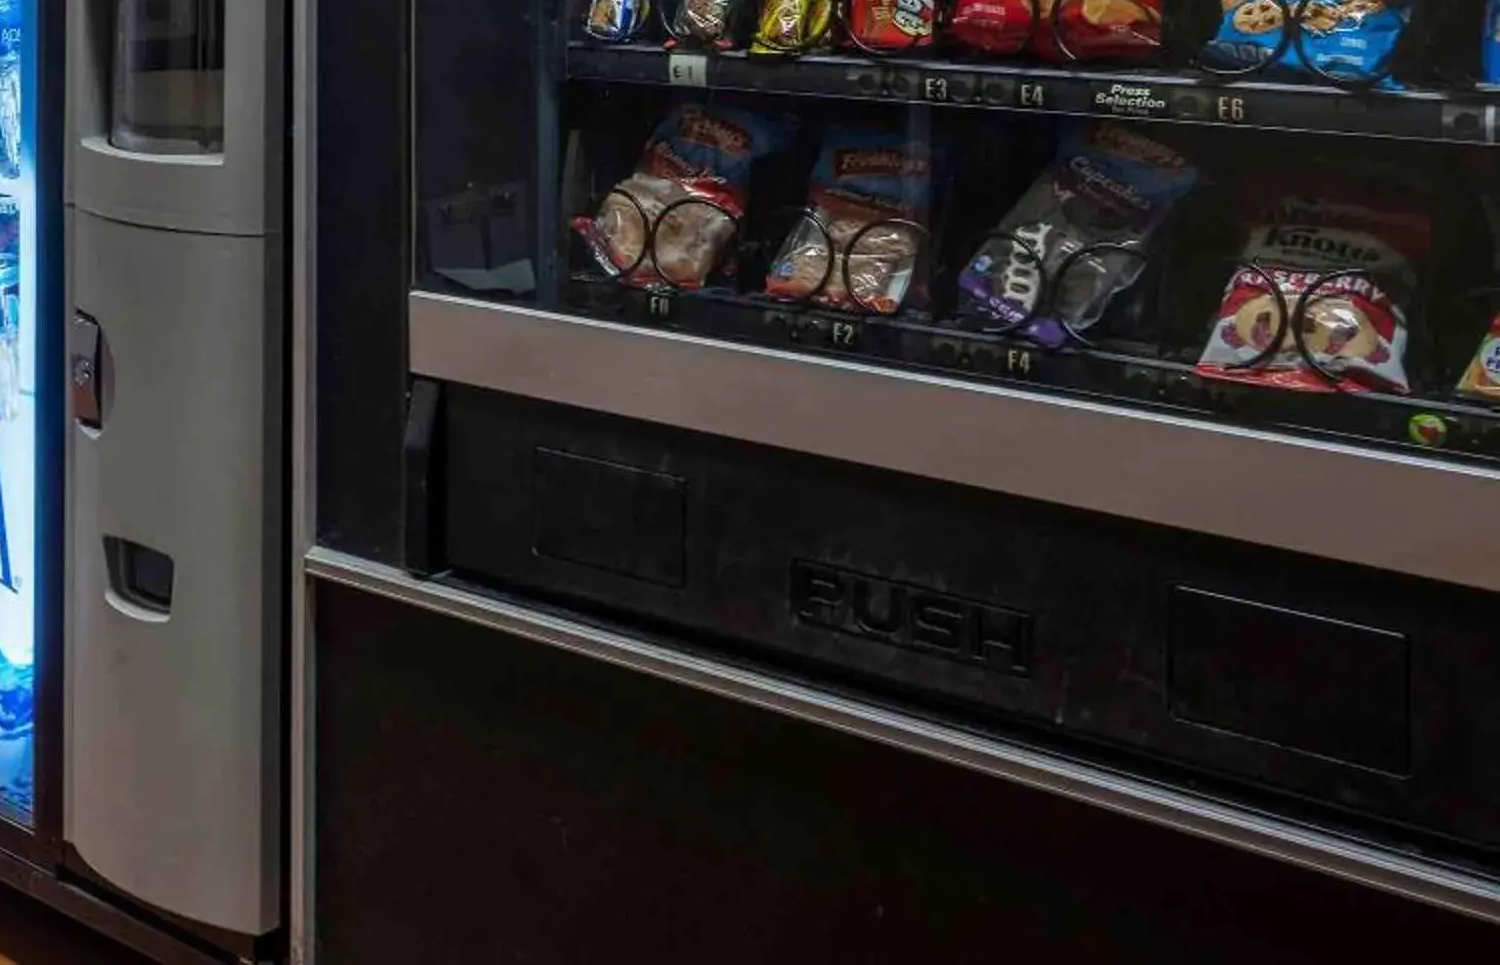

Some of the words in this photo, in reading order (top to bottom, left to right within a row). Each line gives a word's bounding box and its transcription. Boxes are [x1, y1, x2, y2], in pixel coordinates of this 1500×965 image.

[925, 78, 947, 101] E3
[1021, 84, 1042, 106] E4
[1095, 92, 1166, 108] Selection
[1218, 96, 1244, 121] E6
[793, 565, 1031, 676] PUSH
